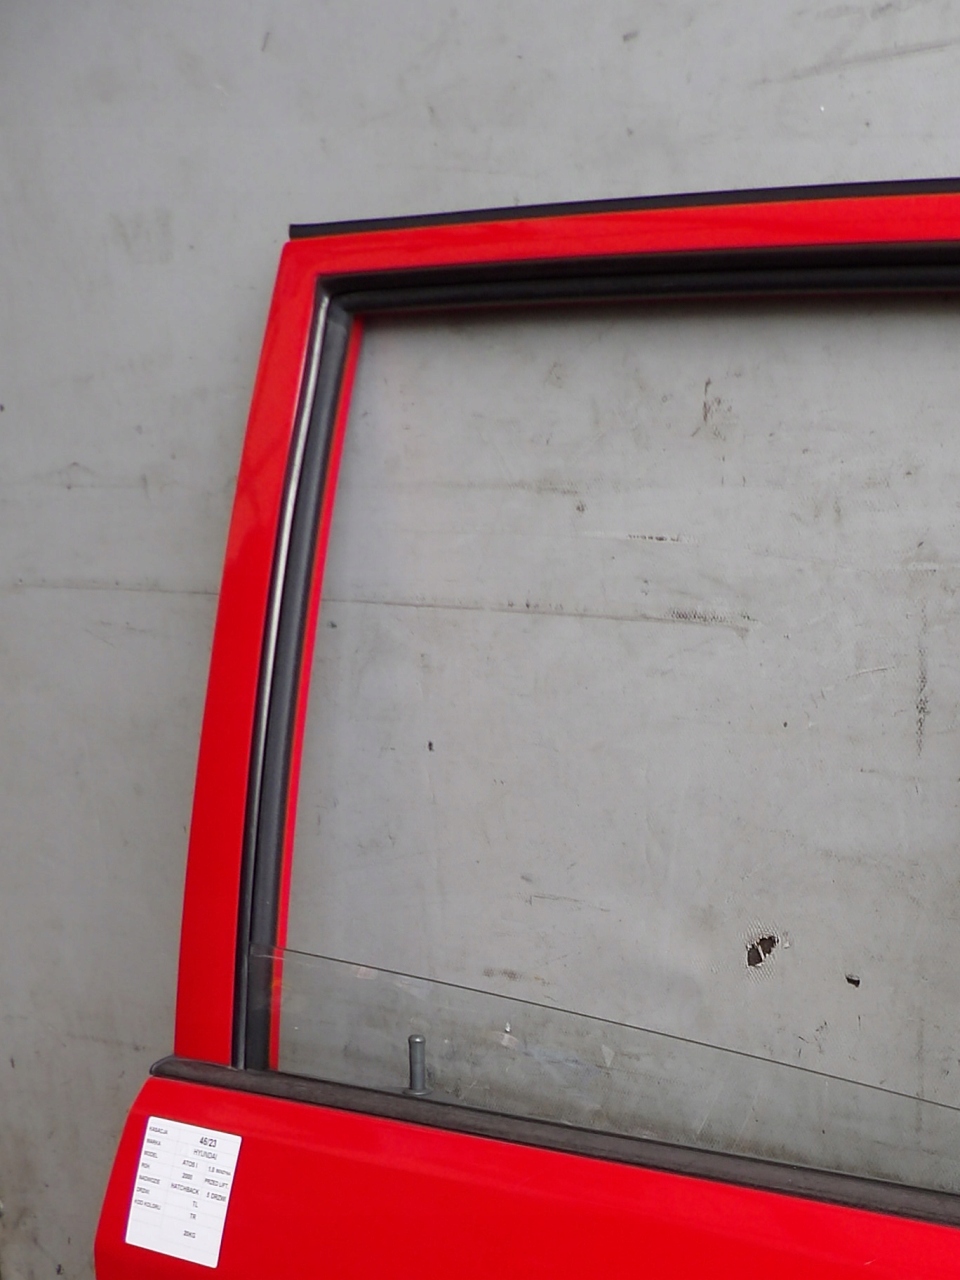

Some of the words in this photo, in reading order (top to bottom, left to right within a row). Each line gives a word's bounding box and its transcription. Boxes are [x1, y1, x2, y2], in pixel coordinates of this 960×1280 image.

[199, 1137, 217, 1147] 46/23
[193, 1149, 218, 1160] HYUNDAI
[171, 1183, 199, 1195] HATCHBACK
